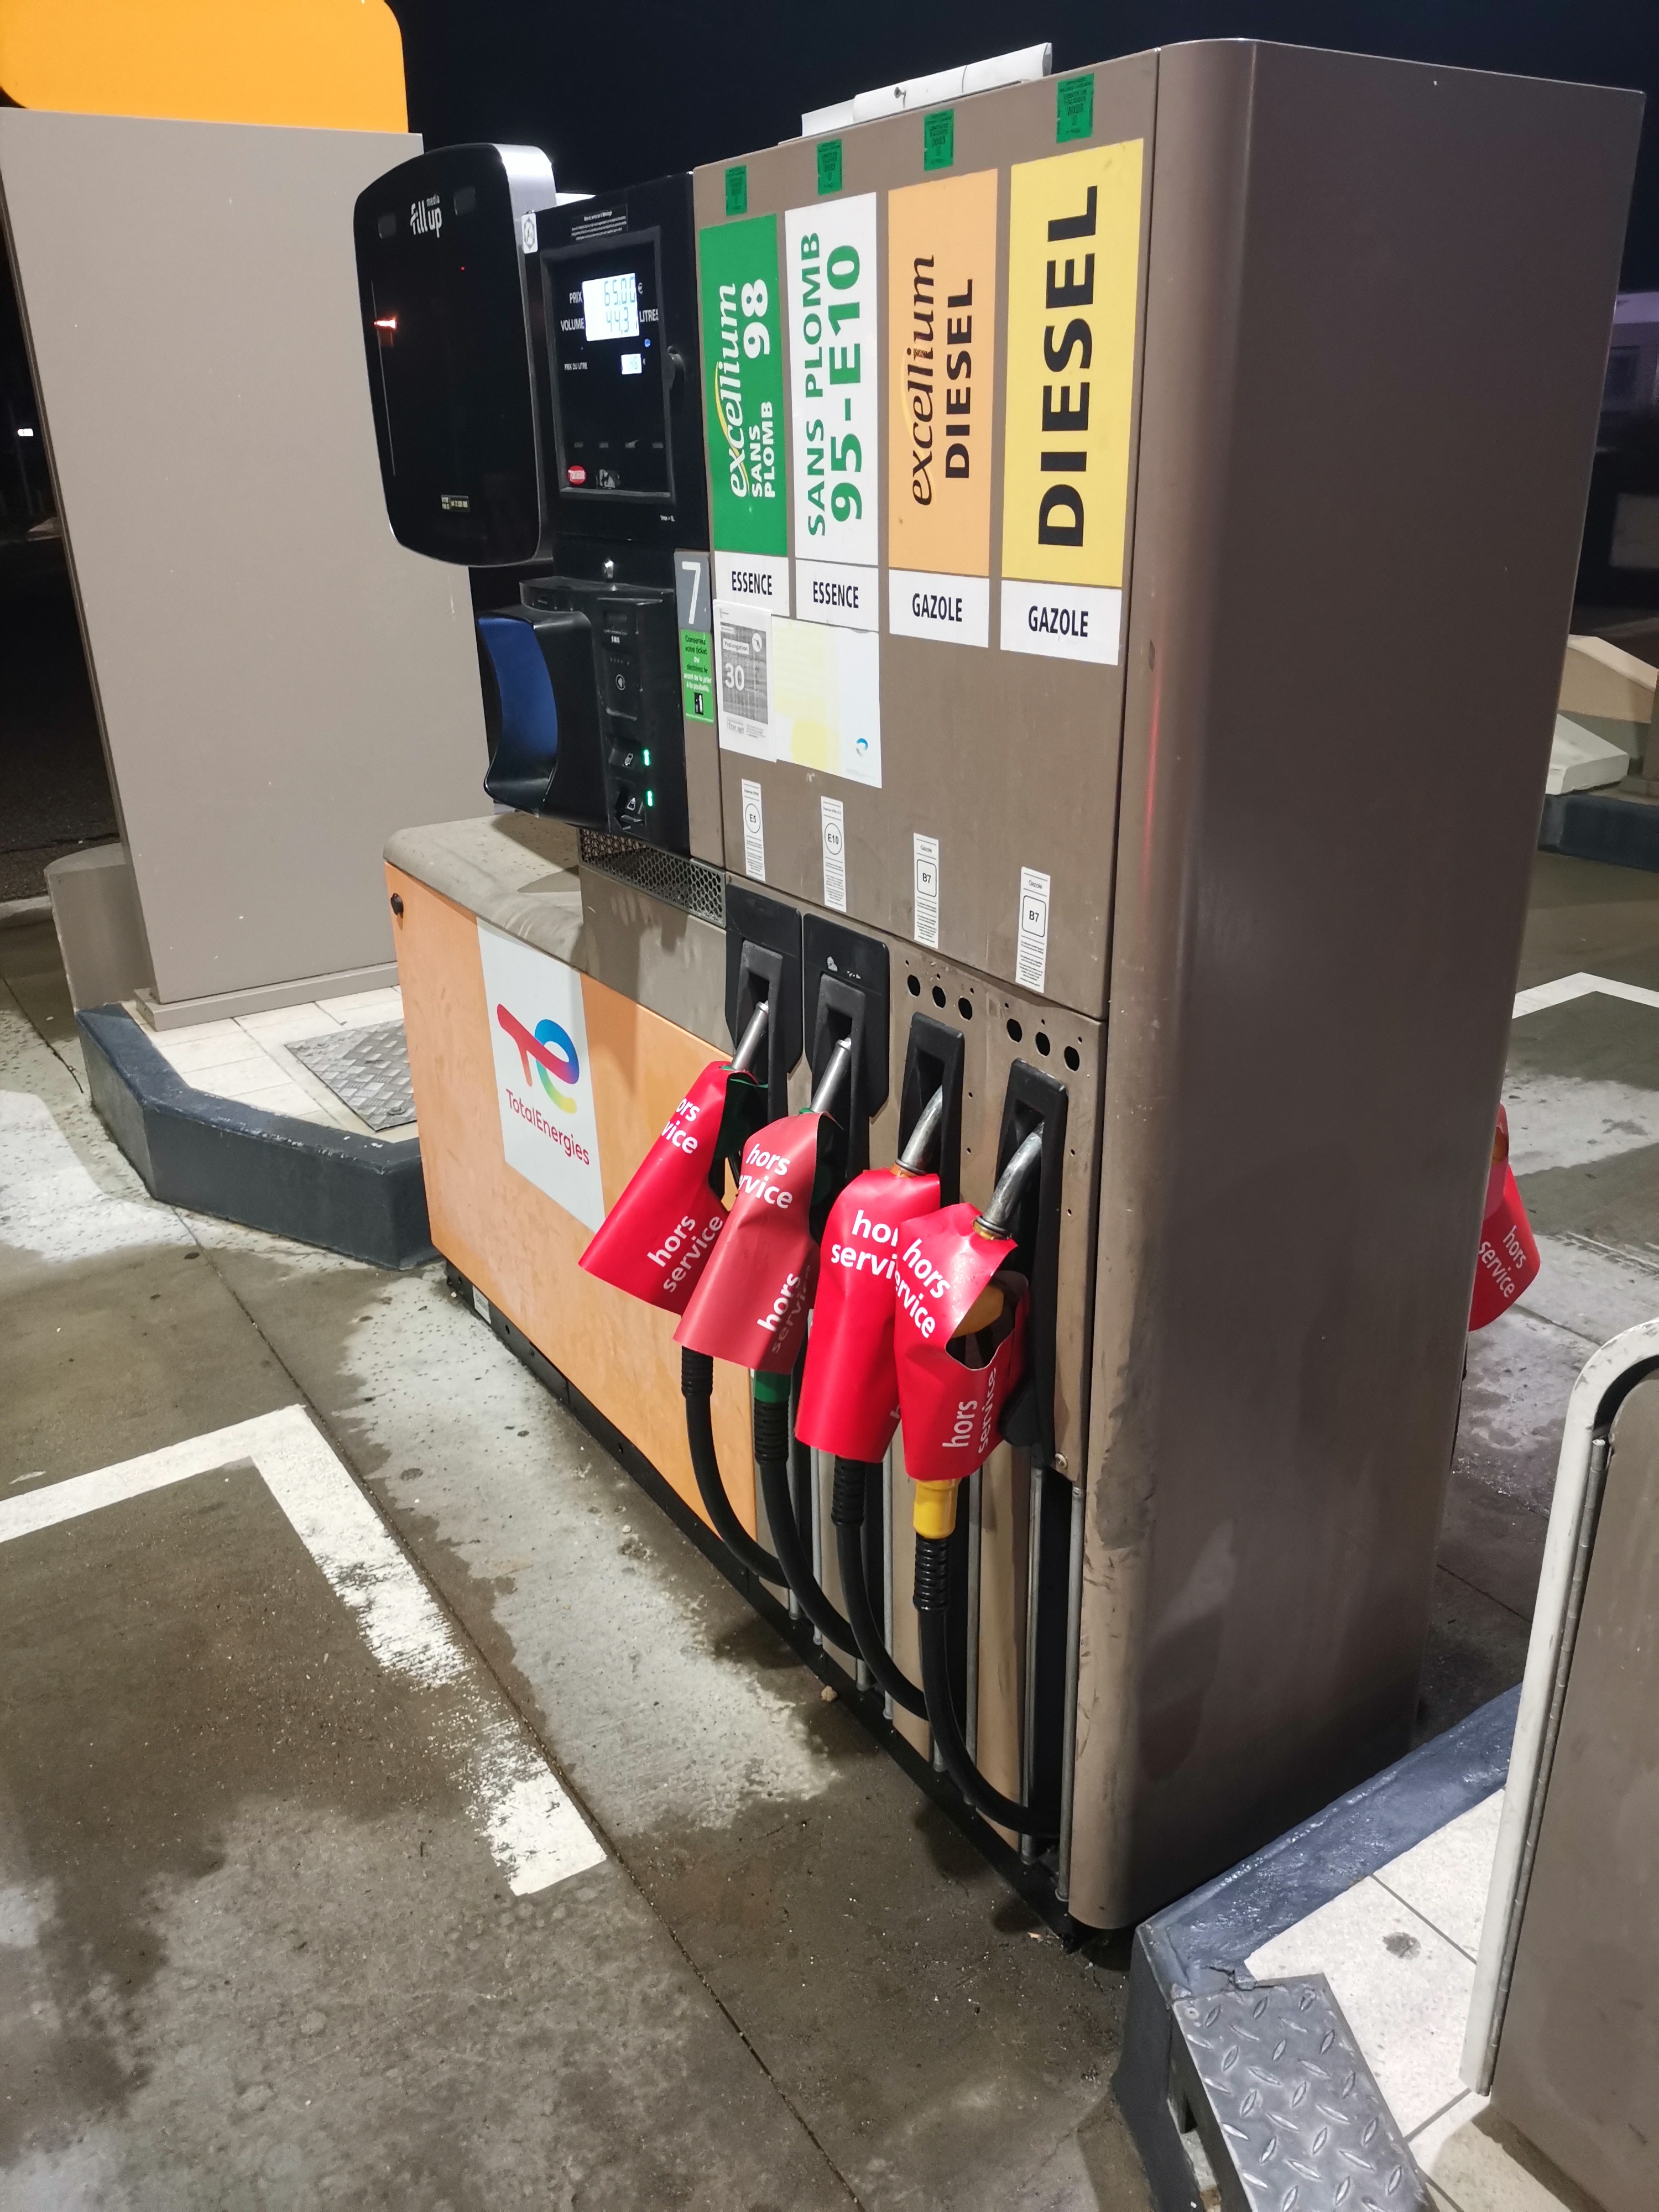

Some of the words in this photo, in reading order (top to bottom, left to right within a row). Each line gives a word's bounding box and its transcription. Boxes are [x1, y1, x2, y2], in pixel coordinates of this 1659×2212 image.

[410, 200, 428, 236] fill
[428, 207, 442, 238] up
[560, 317, 585, 332] VOLUME
[639, 308, 659, 323] LITRES
[569, 291, 583, 304] PRIX
[741, 279, 770, 359] 98
[801, 232, 824, 398] PLOMB
[827, 245, 863, 523] 95-E10
[907, 254, 935, 506] excellium
[945, 278, 973, 479] DIESEL
[1038, 185, 1098, 547] DIESEL
[719, 283, 748, 498] excellium
[749, 425, 763, 498] SANS
[761, 401, 776, 499] PLOMB
[807, 419, 826, 537] SANS
[682, 561, 701, 624] 7
[732, 571, 773, 595] ESSENCE
[813, 581, 859, 608] ESSENCE
[912, 593, 962, 622] GAZOLE
[1028, 606, 1088, 637] GAZOLE
[724, 662, 744, 691] 30
[749, 813, 757, 823] E5
[827, 833, 839, 844] E10
[922, 872, 931, 883] B7
[1029, 910, 1040, 922] B7
[505, 1088, 590, 1166] TotalEnergies
[676, 1098, 701, 1121] ors
[661, 1120, 698, 1154] vice
[746, 1143, 791, 1176] hors
[738, 1175, 792, 1209] rvice
[647, 1215, 696, 1267] hors
[852, 1209, 898, 1247] ho
[1503, 1224, 1527, 1270] hors
[663, 1216, 723, 1293] service
[831, 1243, 897, 1280] servi
[902, 1238, 951, 1298] hors
[1478, 1241, 1515, 1298] service
[757, 1272, 801, 1333] hors
[895, 1270, 936, 1339] ervice
[942, 1400, 978, 1448] hors
[978, 1368, 996, 1454] service
